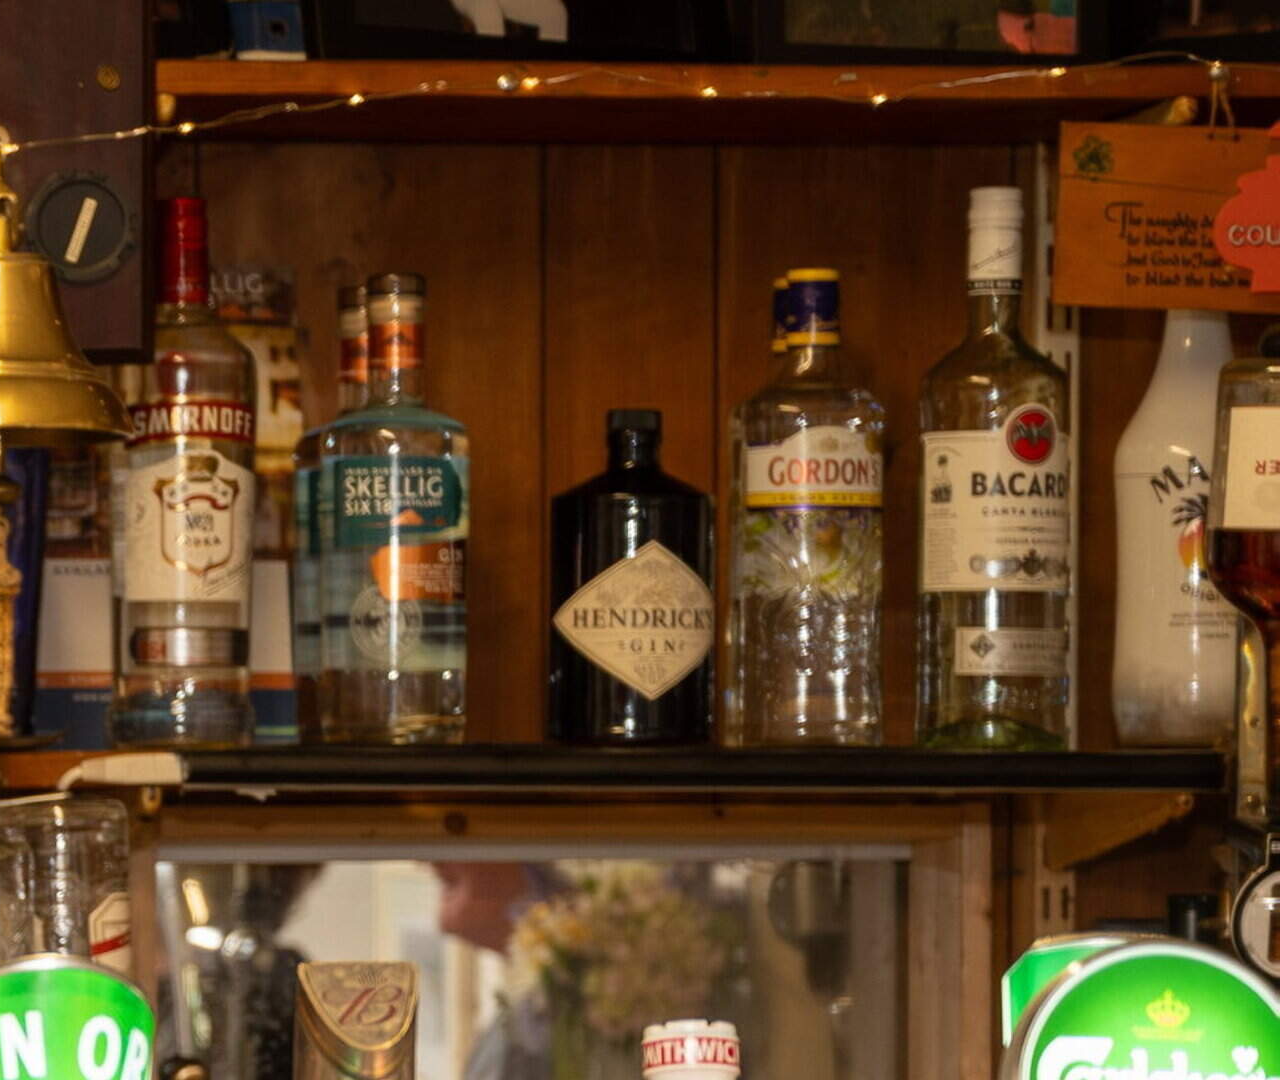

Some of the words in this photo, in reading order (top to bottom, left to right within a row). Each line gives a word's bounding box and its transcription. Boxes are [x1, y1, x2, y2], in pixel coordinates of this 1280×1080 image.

[1255, 459, 1280, 475] ER
[344, 475, 445, 499] SKELLIG
[970, 472, 1068, 497] BACARD
[629, 638, 678, 653] GIN
